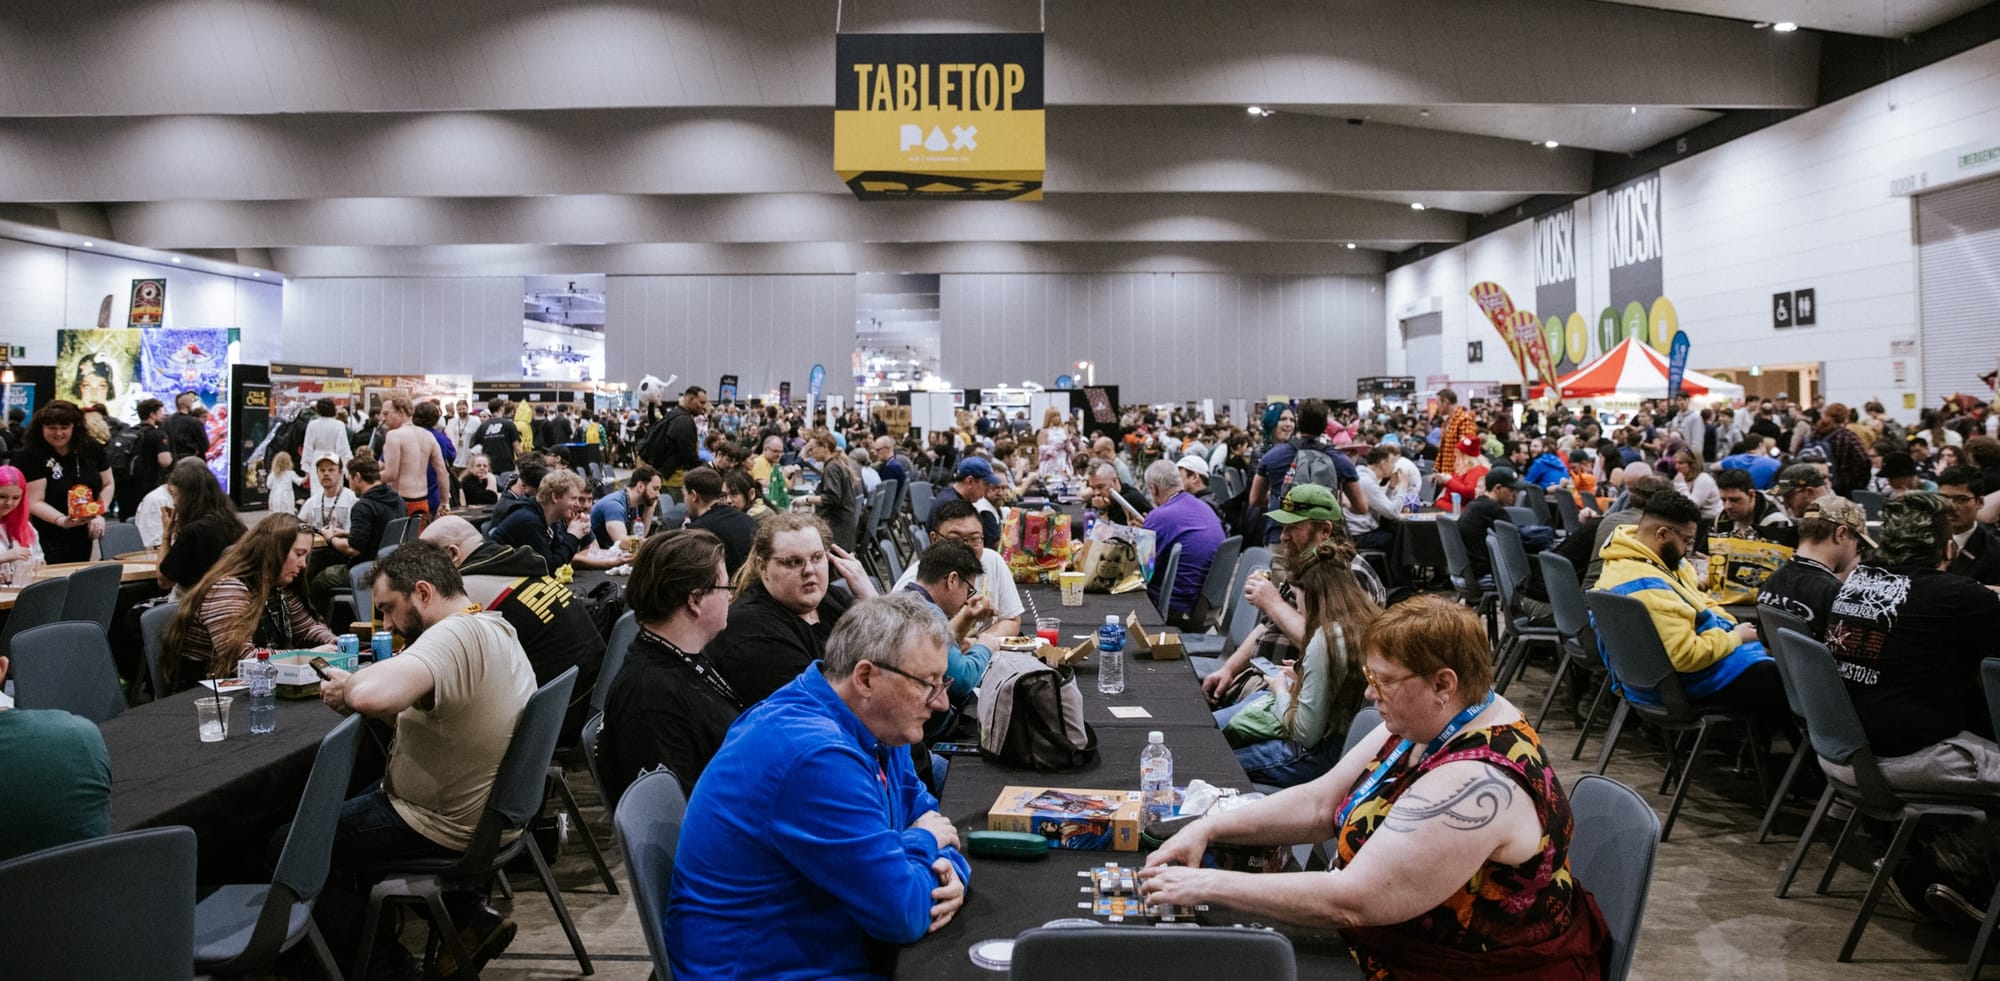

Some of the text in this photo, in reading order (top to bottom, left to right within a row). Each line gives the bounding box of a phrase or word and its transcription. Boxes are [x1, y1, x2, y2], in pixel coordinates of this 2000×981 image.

[853, 63, 1025, 111] TABLETOP
[900, 124, 977, 151] PAX
[860, 181, 1027, 192] PAX
[1608, 177, 1661, 269] KIOSK
[1535, 209, 1575, 287] KIOSK
